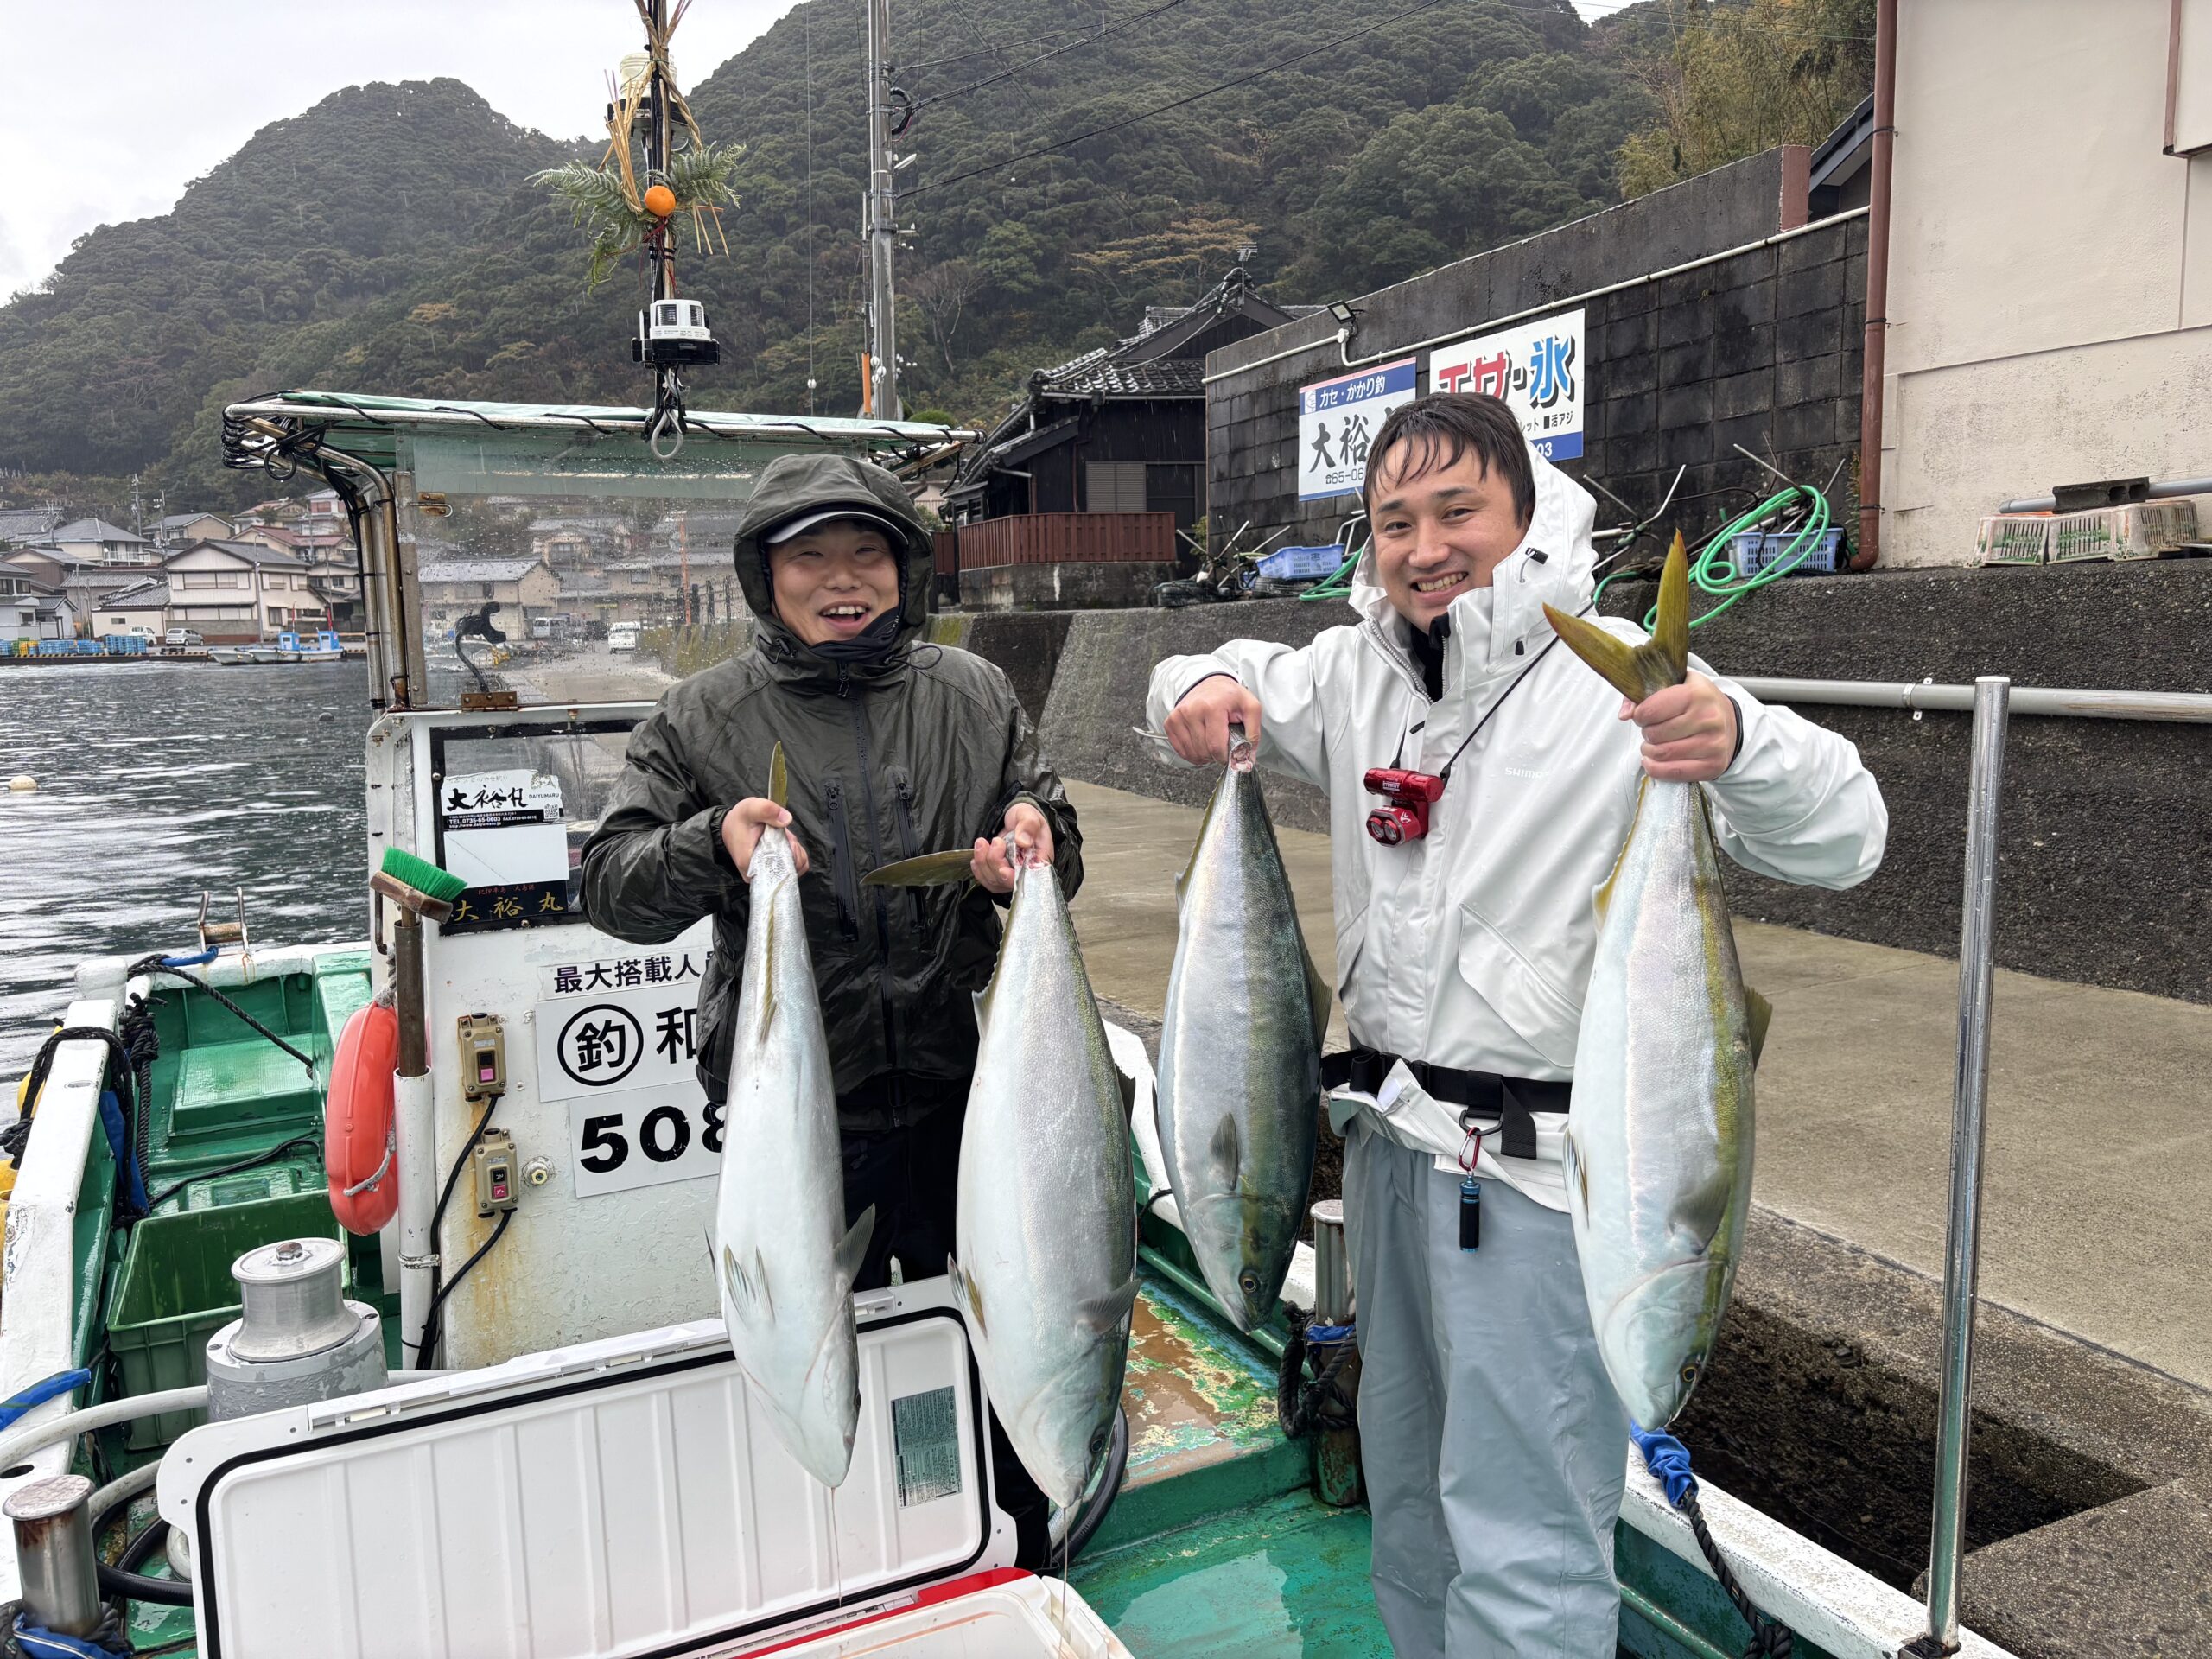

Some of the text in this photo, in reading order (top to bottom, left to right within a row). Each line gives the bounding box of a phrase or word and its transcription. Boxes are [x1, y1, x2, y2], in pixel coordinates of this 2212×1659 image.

[1319, 374, 1386, 408] カセ・かかり釣
[1439, 335, 1575, 410] エサ・氷
[1308, 407, 1393, 474] 大裕
[446, 784, 529, 812] 大裕丸
[454, 891, 564, 922] 大裕丸
[554, 951, 714, 994] 最大搭載人
